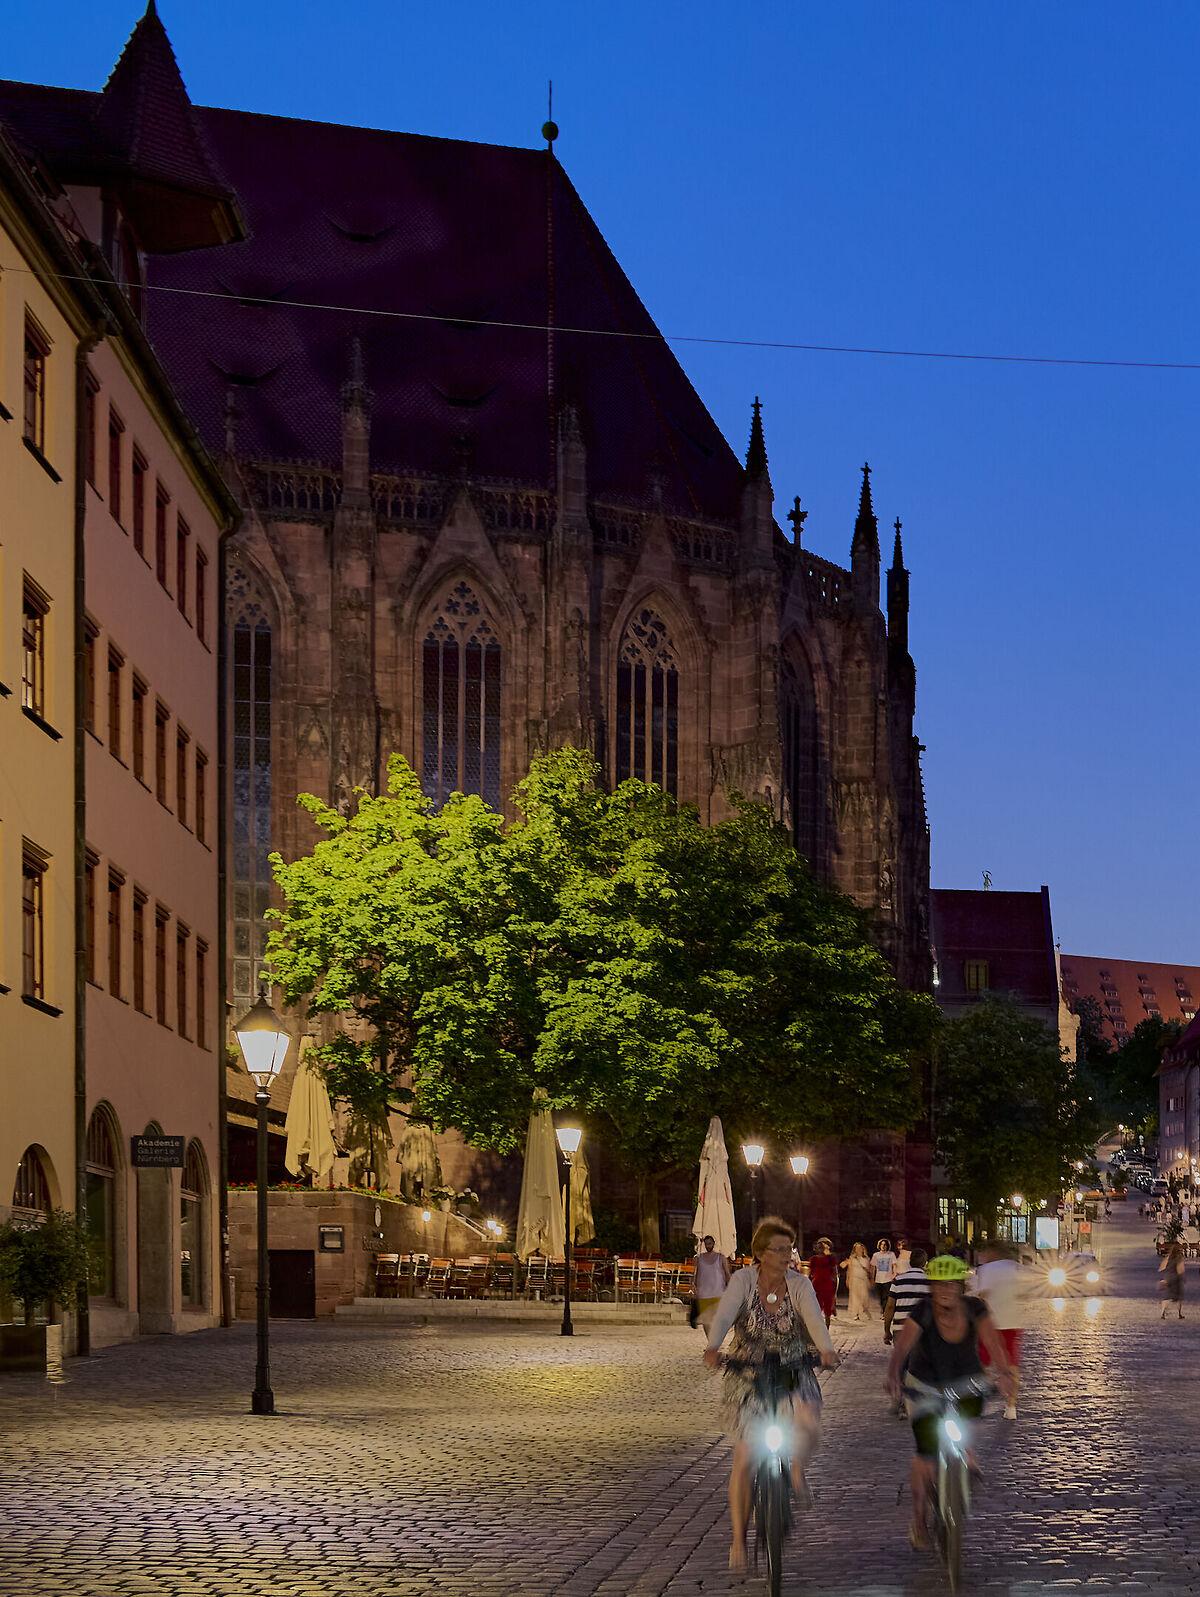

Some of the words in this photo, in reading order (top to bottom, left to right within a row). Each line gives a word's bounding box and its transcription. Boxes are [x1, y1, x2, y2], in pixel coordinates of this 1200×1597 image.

[137, 1139, 180, 1147] Akademie
[137, 1147, 176, 1155] Galerie
[137, 1155, 180, 1163] Nürnberg
